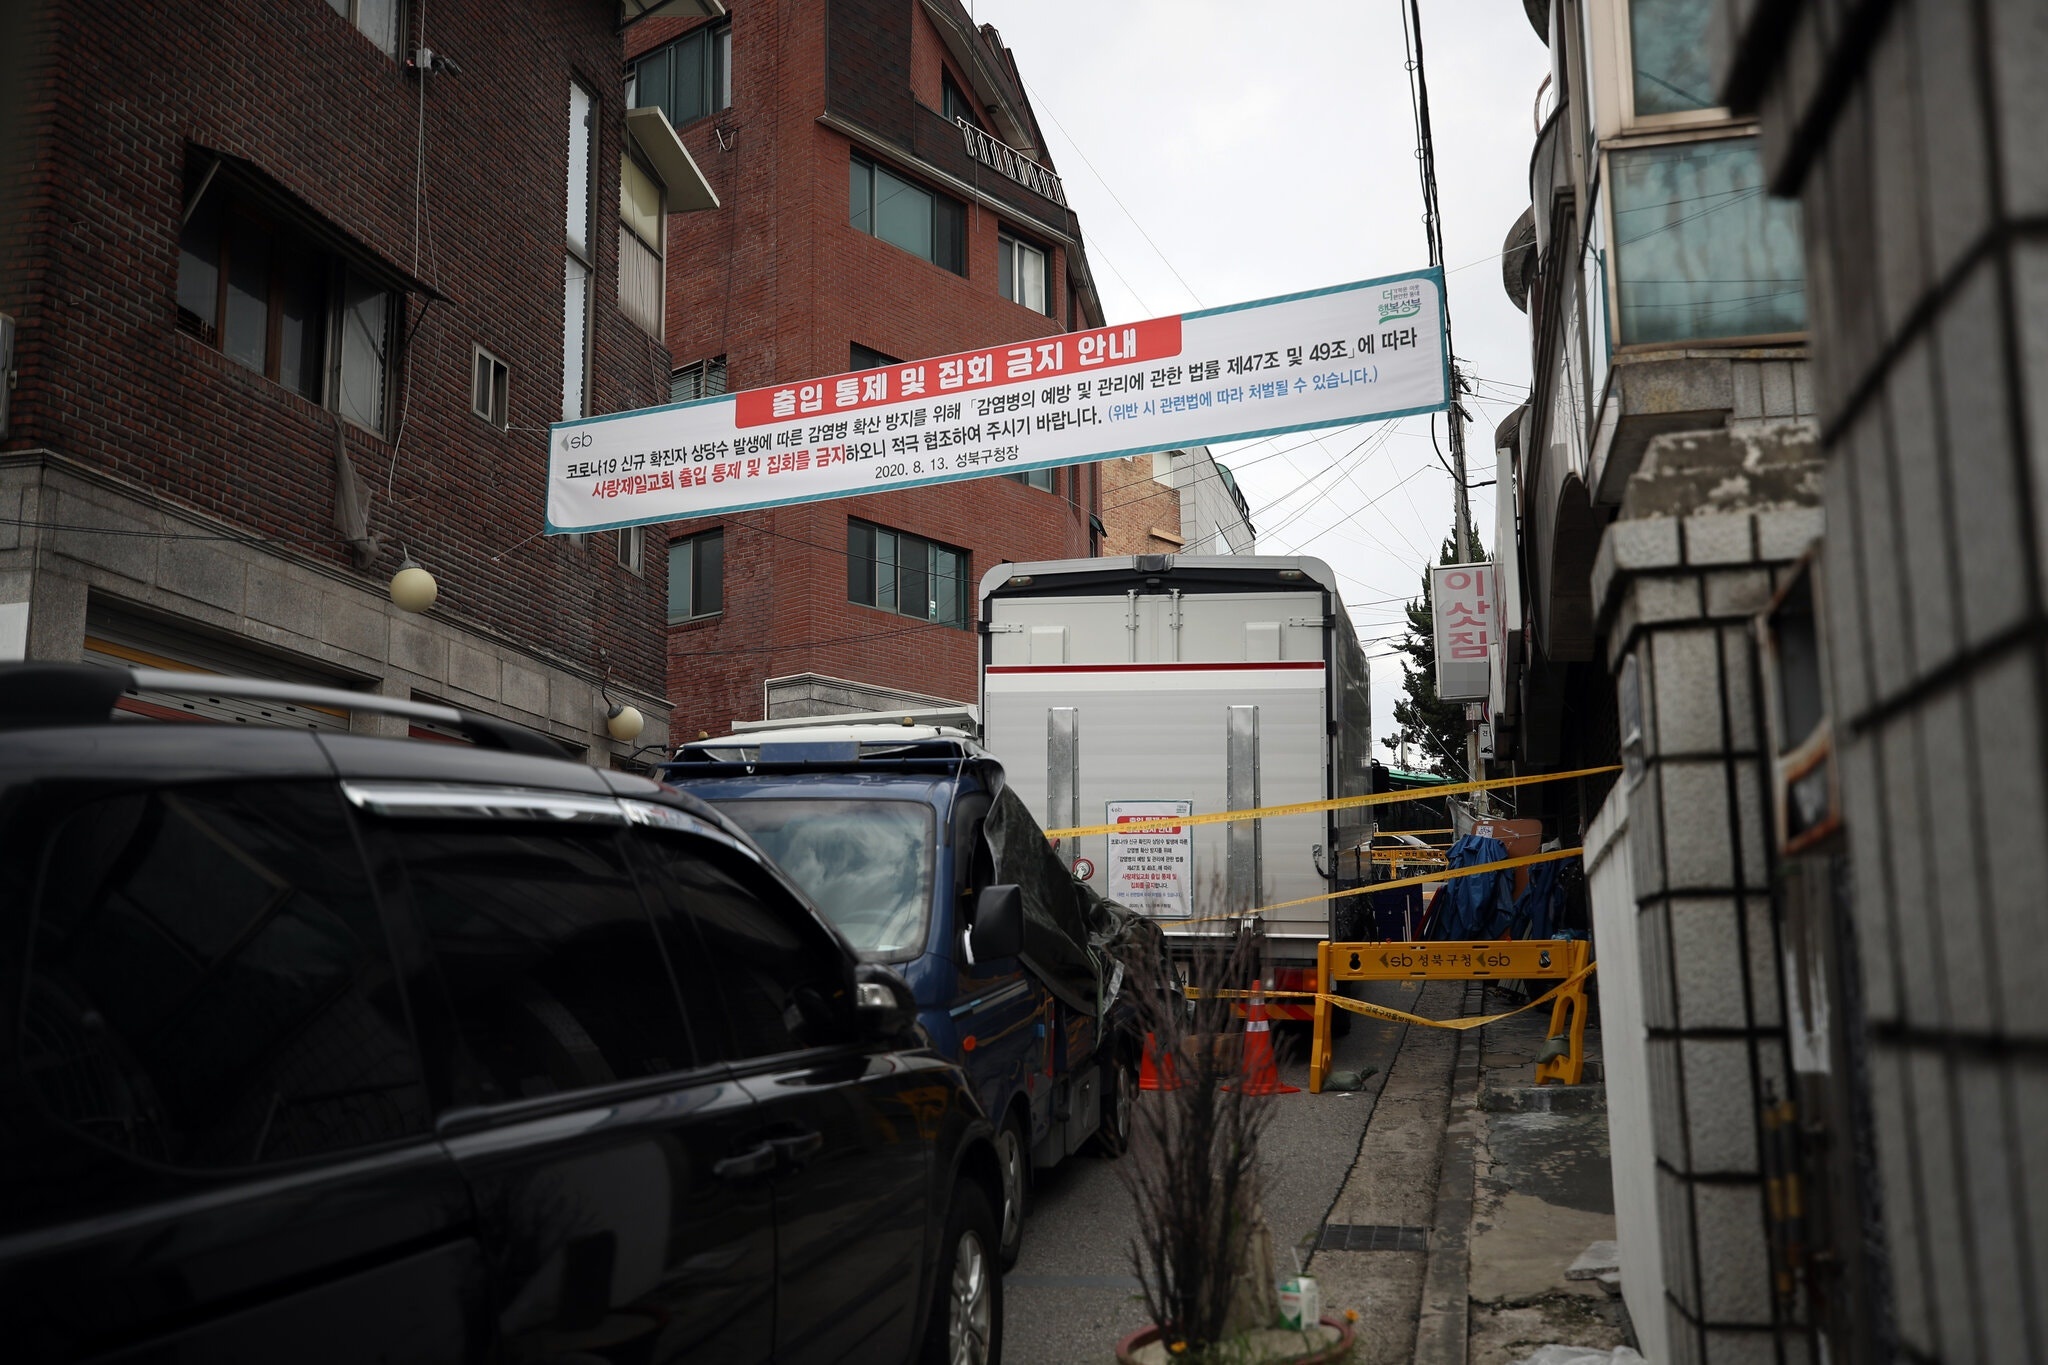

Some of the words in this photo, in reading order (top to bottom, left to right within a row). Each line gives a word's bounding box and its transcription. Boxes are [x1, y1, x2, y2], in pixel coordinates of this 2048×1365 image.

[1382, 289, 1393, 300] 더
[566, 458, 617, 479] 코로나19
[620, 454, 646, 472] 신규
[649, 447, 688, 467] 확진자
[691, 440, 729, 462] 상당수
[733, 433, 772, 454] 발생에
[777, 428, 802, 448] 따른
[808, 421, 848, 444] 감염병
[852, 414, 881, 435] 확산
[886, 408, 928, 429] 방지를
[932, 402, 961, 423] 위해
[970, 390, 1035, 417] 「감염병의
[1041, 384, 1072, 404] 예방
[1077, 380, 1092, 400] 및
[1097, 372, 1144, 396] 관리에
[1150, 366, 1183, 388] 관한
[1188, 359, 1221, 382] 법률
[1227, 351, 1280, 376] 제47조
[1287, 346, 1303, 367] 및
[1309, 334, 1375, 362] 49조」에
[1381, 327, 1417, 351] 따라
[772, 383, 823, 418] 출입
[835, 372, 887, 408] 통제
[900, 366, 925, 396] 및
[938, 354, 993, 390] 집회
[1006, 341, 1063, 378] 금지
[1078, 328, 1137, 366] 안내
[570, 431, 593, 449] sb
[592, 470, 675, 499] 사랑제일교회
[678, 466, 707, 488] 출입
[712, 461, 742, 482] 통제
[747, 458, 761, 478] 및
[766, 450, 810, 475] 집회를
[815, 439, 886, 467] 금지하오니
[892, 434, 919, 455] 적극
[923, 426, 981, 450] 협조하여
[986, 415, 1030, 441] 주시기
[1036, 406, 1102, 432] 바랍니다.
[1108, 402, 1138, 423] (위반
[1143, 399, 1156, 416] 시
[1160, 390, 1212, 414] 관련법에
[1217, 386, 1244, 403] 따라
[1249, 379, 1289, 400] 처벌될
[1293, 377, 1308, 394] 수
[1313, 366, 1378, 391] 있습니다.)
[875, 464, 908, 479] 2020.
[912, 461, 924, 474] 8.
[930, 457, 948, 471] 13.
[956, 445, 1019, 468] 성북구청장
[1444, 570, 1490, 659] 이삿짐
[1390, 953, 1413, 967] sb
[1419, 954, 1471, 967] 성북구청
[1488, 952, 1510, 967] sb
